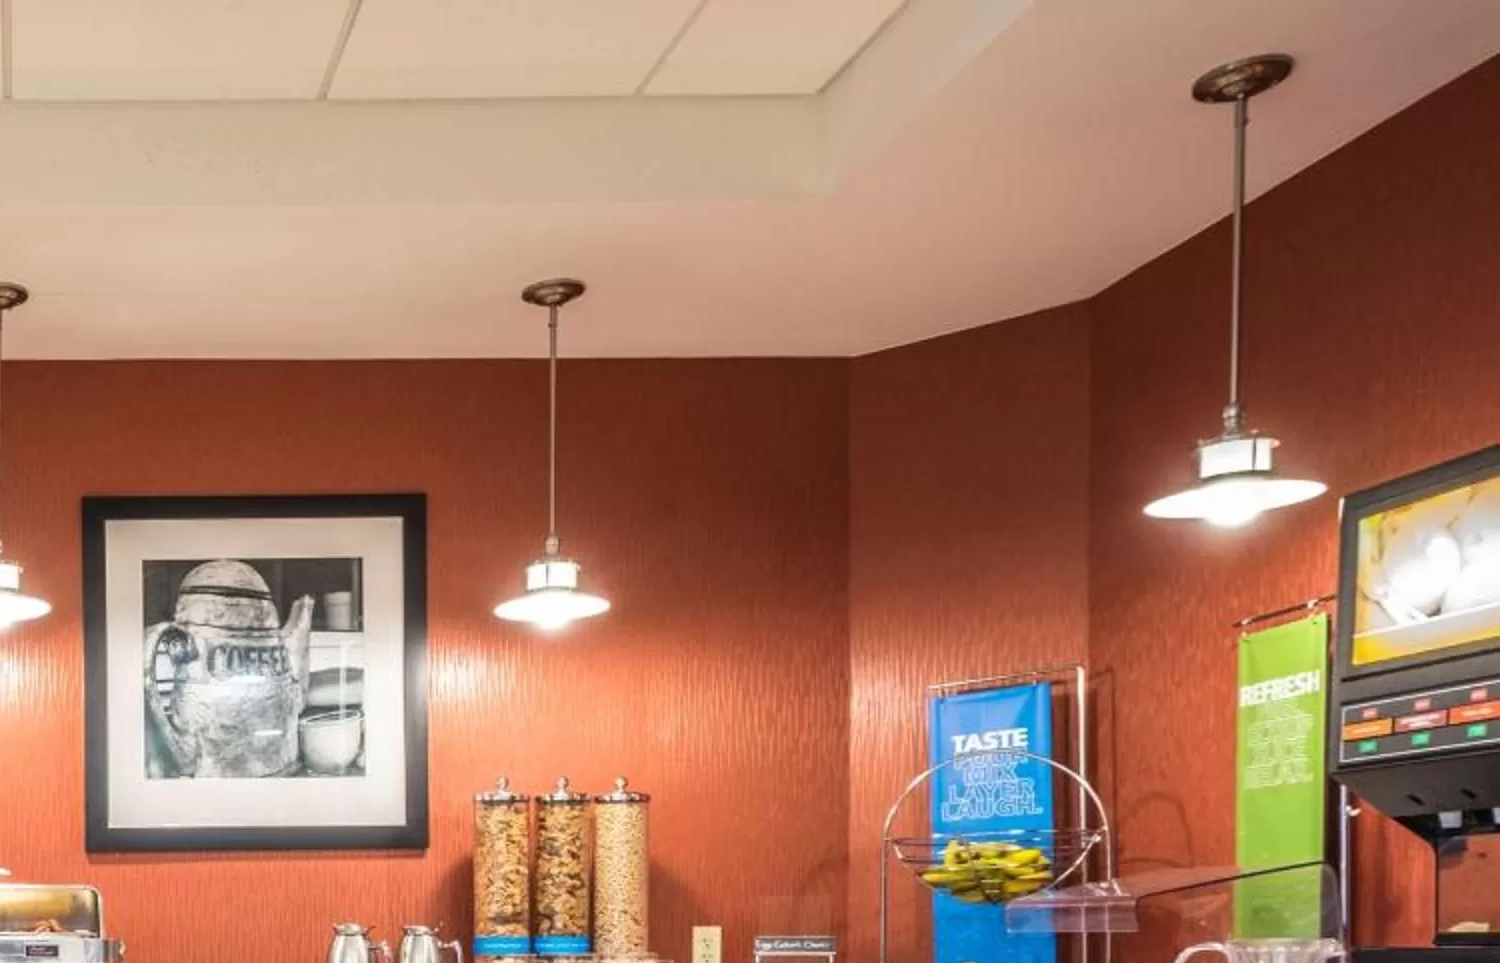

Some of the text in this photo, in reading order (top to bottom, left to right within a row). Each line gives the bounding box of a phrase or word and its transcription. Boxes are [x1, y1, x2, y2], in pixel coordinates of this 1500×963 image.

[206, 644, 289, 676] COFFEE
[1238, 670, 1320, 708] REFRESH
[950, 727, 1029, 754] TASTE
[948, 777, 1035, 804] LAYER
